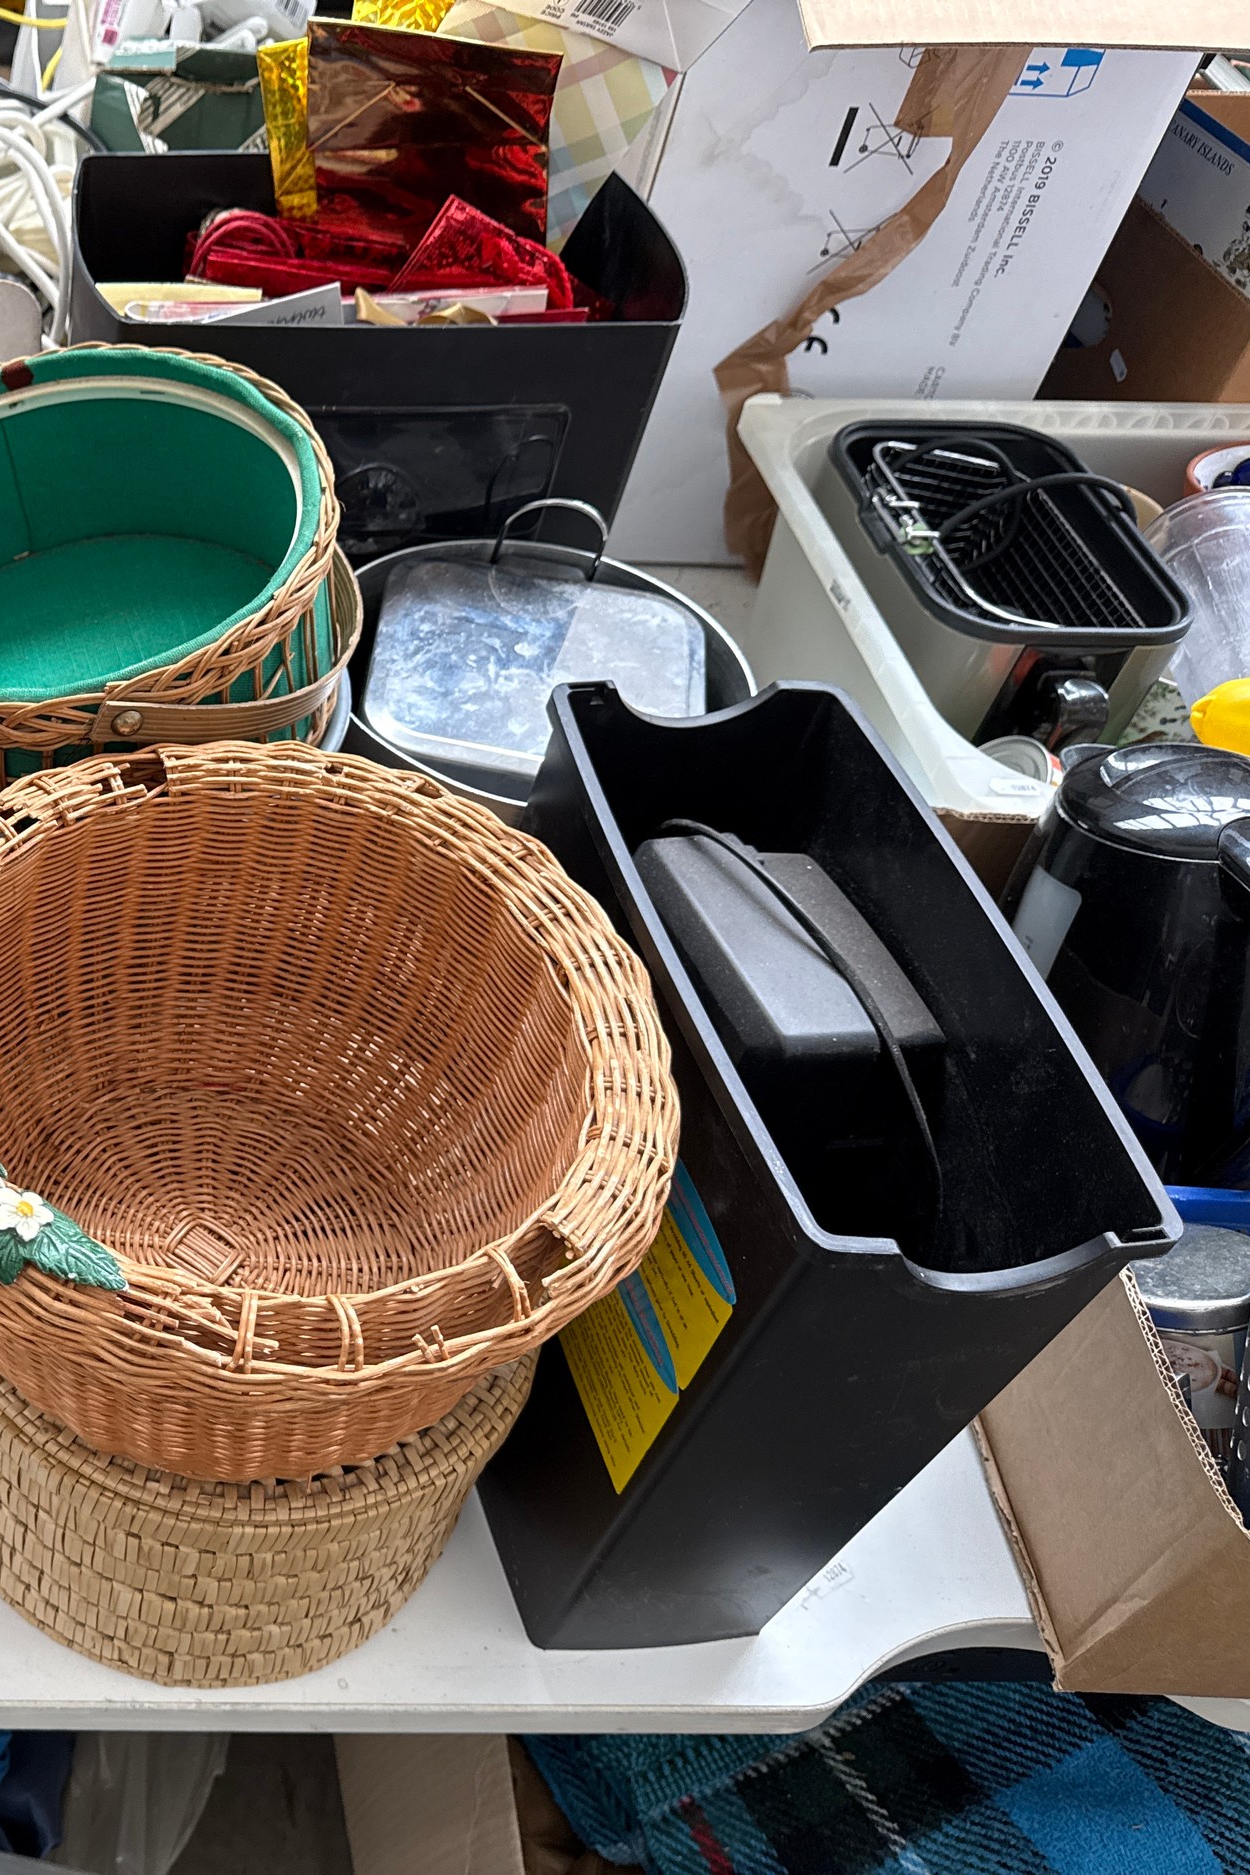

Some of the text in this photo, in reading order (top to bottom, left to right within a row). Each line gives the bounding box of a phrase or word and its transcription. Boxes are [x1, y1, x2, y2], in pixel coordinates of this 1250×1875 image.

[1005, 140, 1022, 163] 1100
[1019, 140, 1045, 184] BISSELL
[1035, 156, 1056, 190] 2019
[1197, 142, 1235, 176] ISLANDS
[968, 140, 1010, 223] The Netherlands
[996, 140, 1034, 212] Postbus 12874
[971, 186, 1000, 244] Amsterdam
[992, 186, 1025, 249] International
[1006, 194, 1040, 251] BISSELL
[974, 251, 997, 286] Trading
[994, 254, 1014, 278] Inc.
